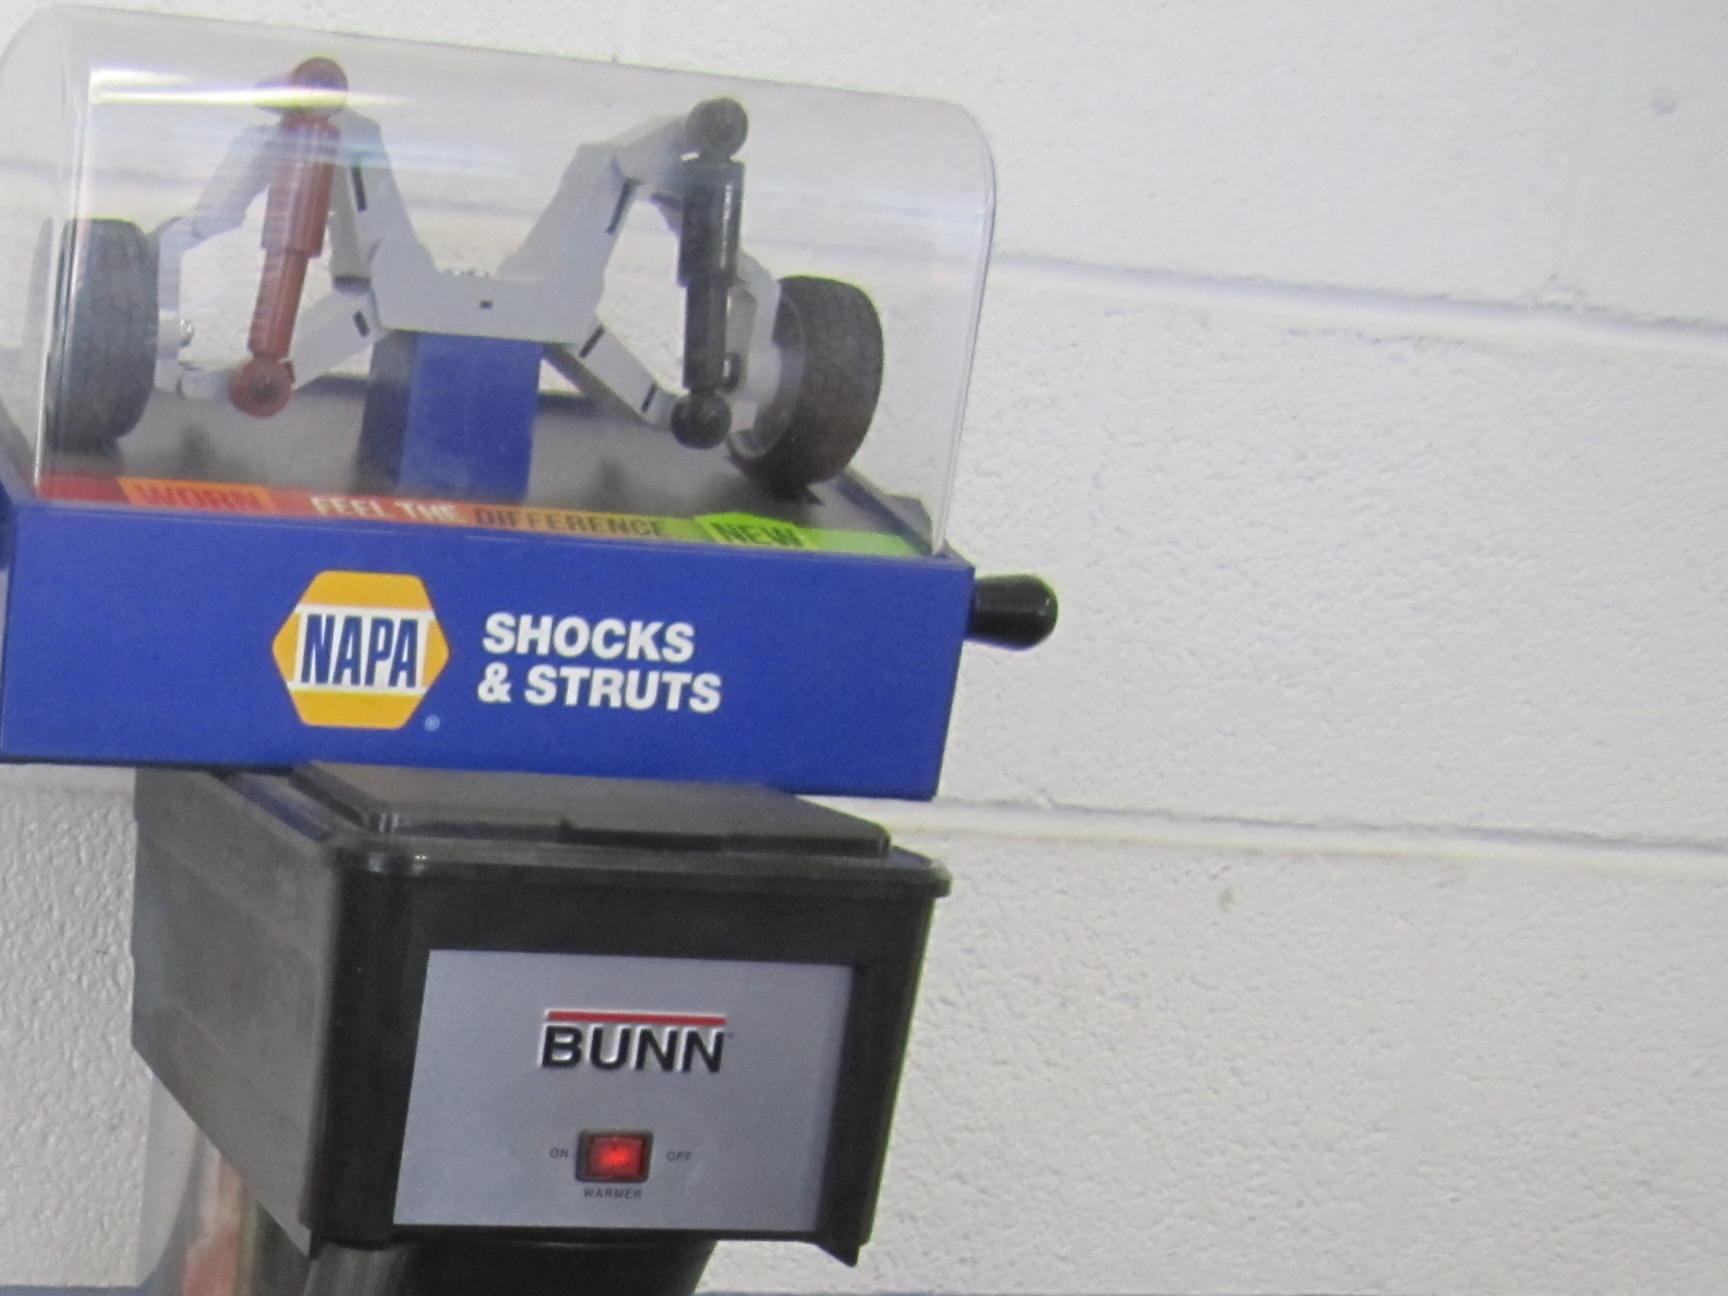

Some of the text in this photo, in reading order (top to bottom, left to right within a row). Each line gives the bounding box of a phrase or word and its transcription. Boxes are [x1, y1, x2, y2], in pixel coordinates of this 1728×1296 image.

[393, 500, 458, 523] THE
[472, 507, 664, 537] DIFFERENCE
[710, 521, 805, 548] NEW
[300, 612, 420, 688] NAPA
[481, 611, 696, 663] SHOCKS
[477, 661, 722, 714] & STRUTS
[539, 1024, 725, 1073] BUNN
[549, 1147, 569, 1158] ON
[666, 1150, 693, 1162] OFF
[583, 1187, 643, 1199] WARMER
